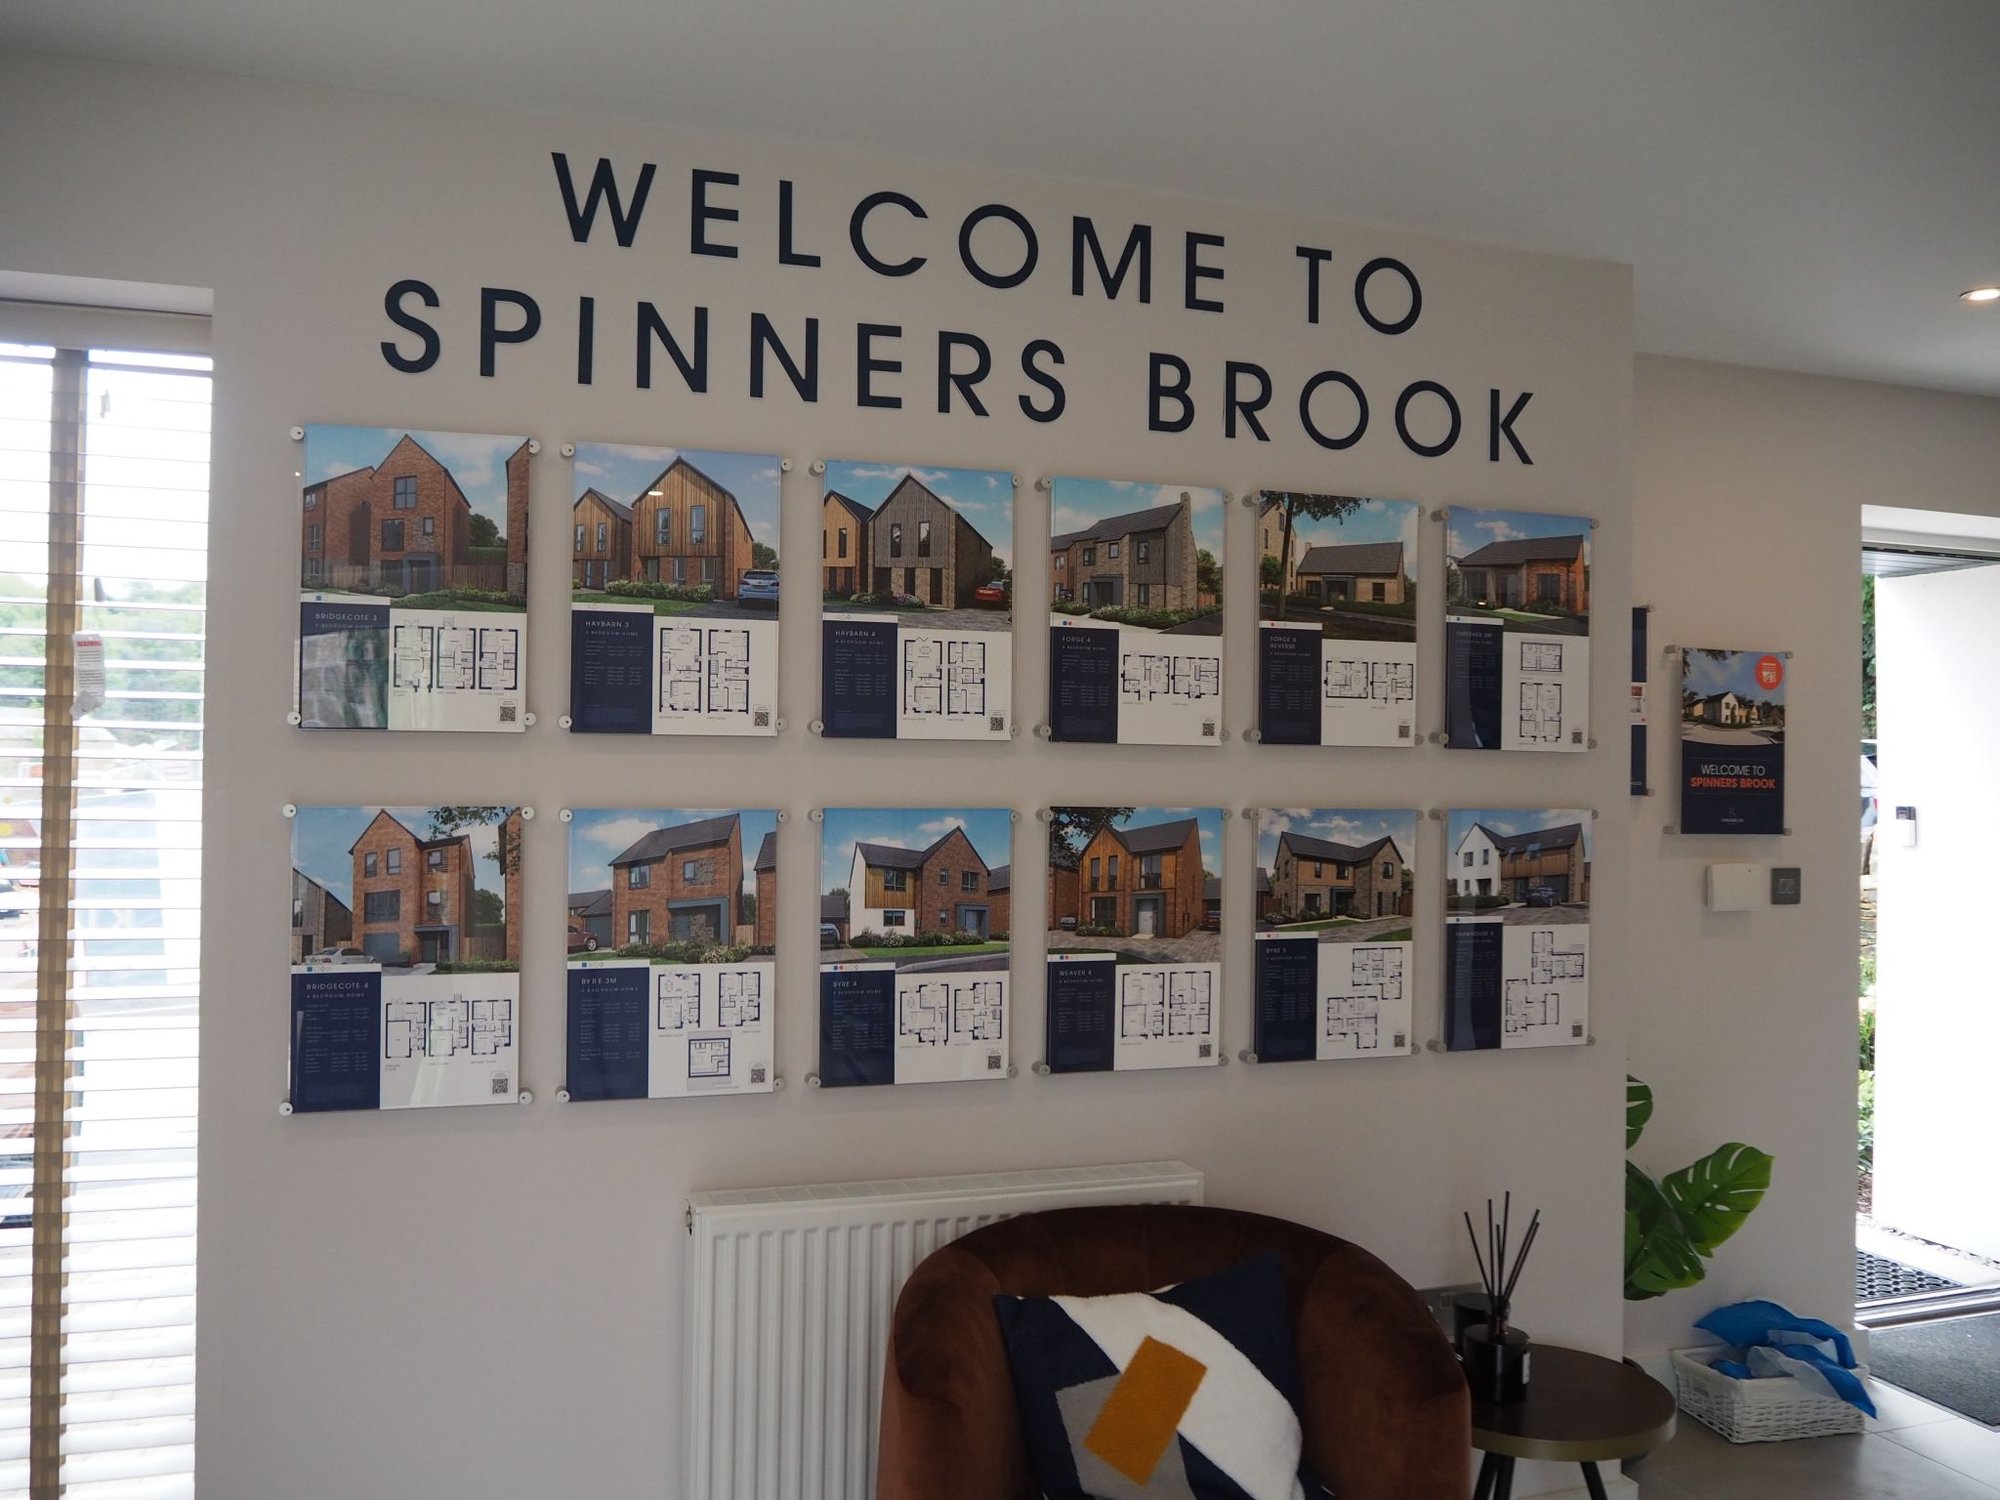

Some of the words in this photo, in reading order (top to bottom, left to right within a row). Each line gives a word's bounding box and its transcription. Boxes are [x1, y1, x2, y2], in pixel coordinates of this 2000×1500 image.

[550, 151, 1226, 314] WELCOME
[1295, 245, 1423, 336] TO
[380, 279, 1066, 423] SPINNERS
[1148, 351, 1535, 466] BROOK
[315, 613, 369, 621] BRIDGECOTE
[585, 620, 622, 628] HAYBARN
[835, 629, 869, 637] HAYBARN
[1701, 764, 1751, 776] WELCOME
[1752, 765, 1766, 777] TO
[1690, 777, 1738, 788] SPINNERS
[1740, 778, 1777, 789] BROOK
[581, 977, 602, 985] BYRE
[833, 980, 849, 988] BYRE
[306, 982, 361, 991] BRIDGECOTE
